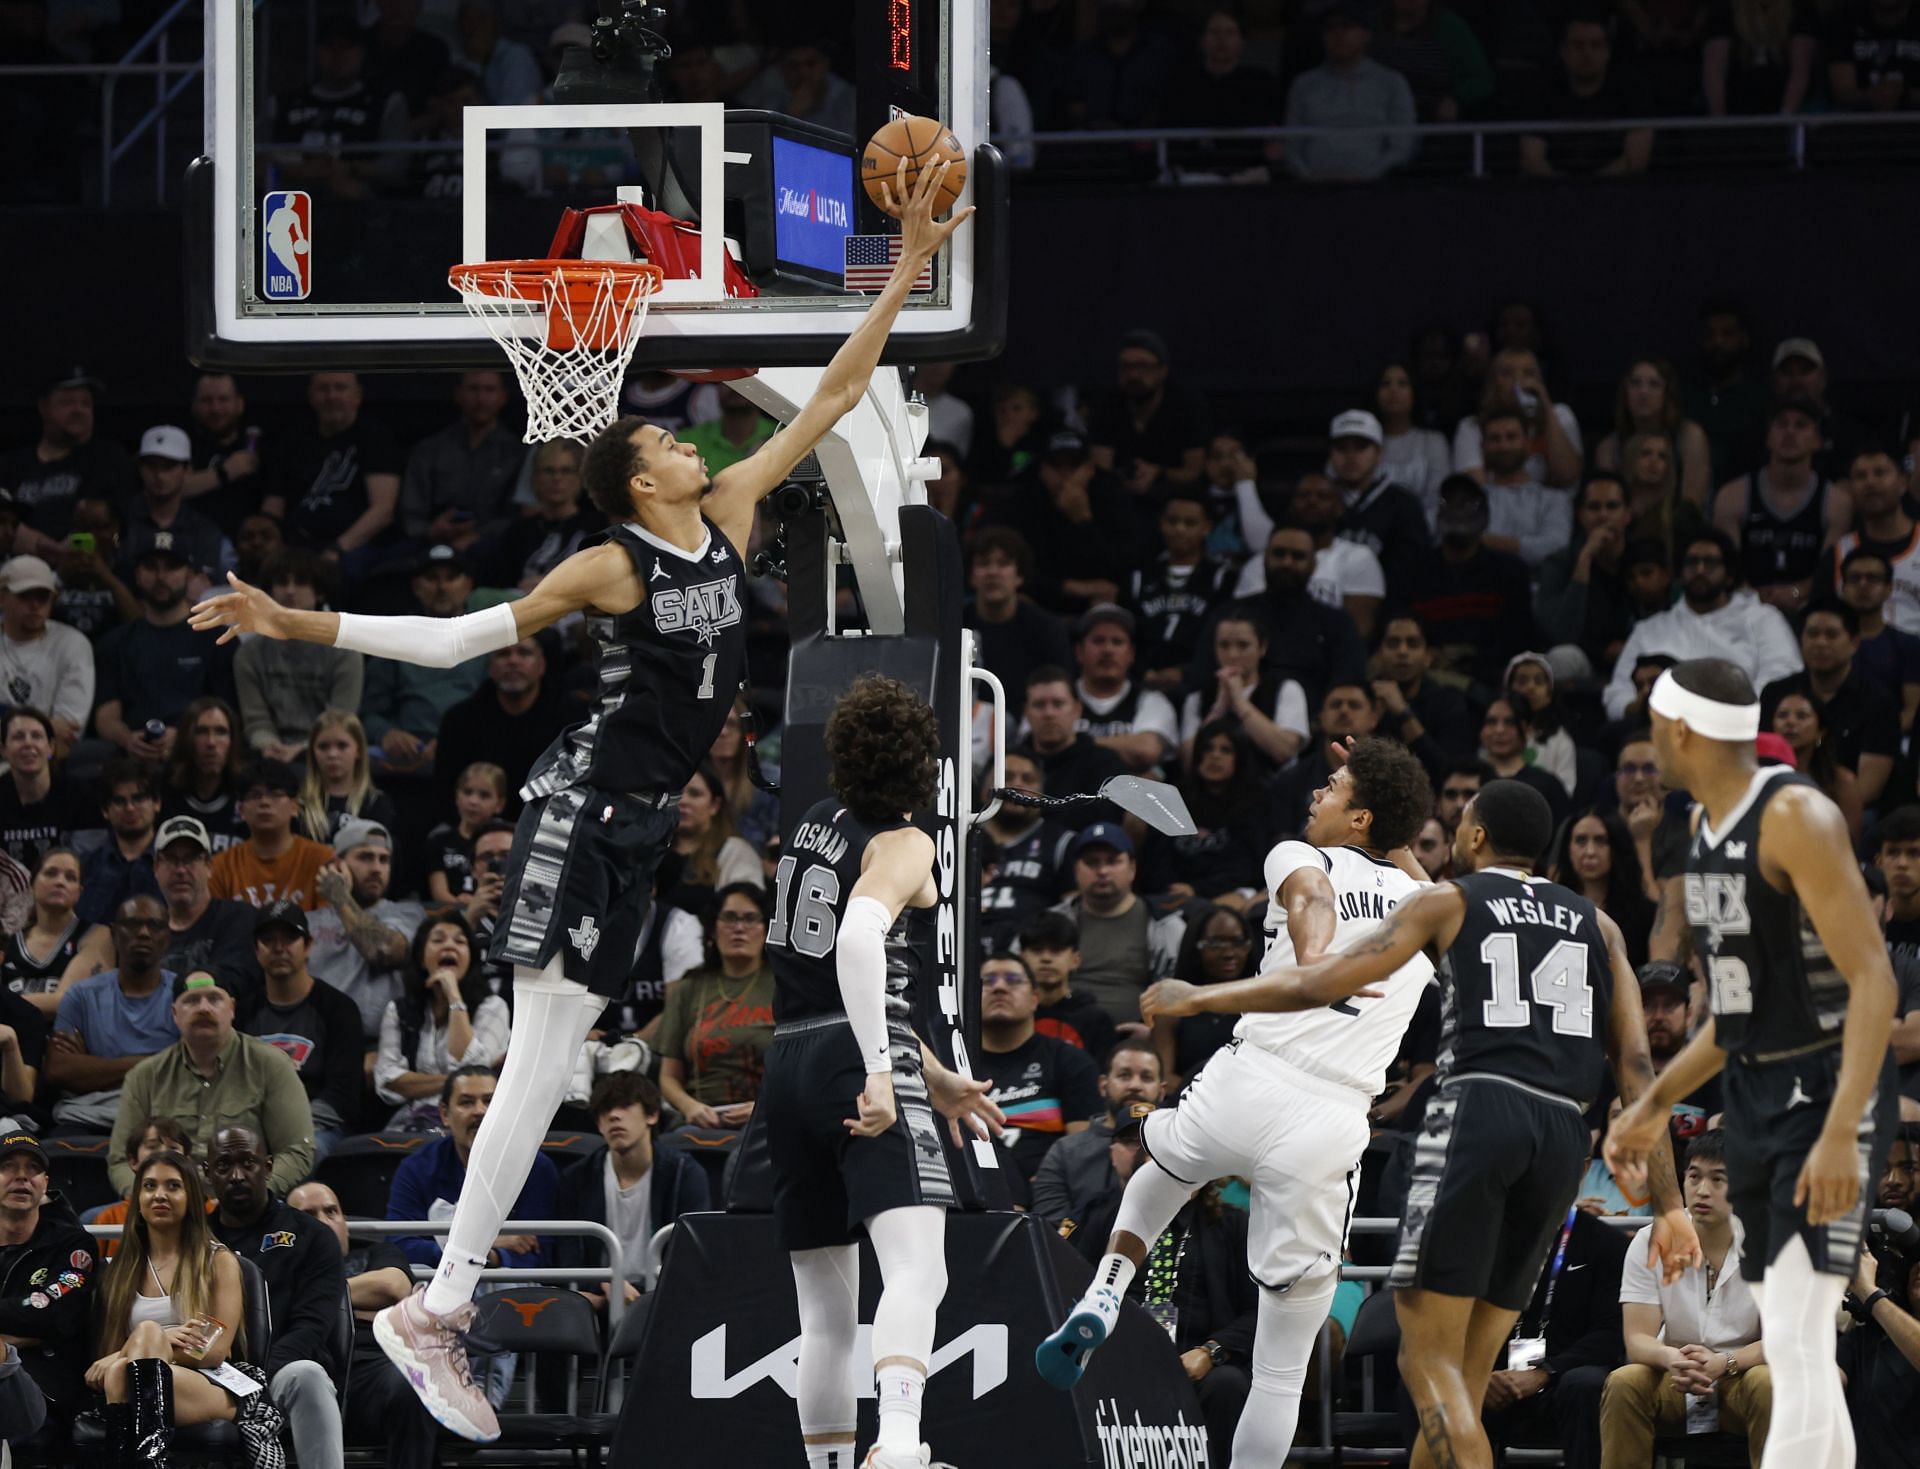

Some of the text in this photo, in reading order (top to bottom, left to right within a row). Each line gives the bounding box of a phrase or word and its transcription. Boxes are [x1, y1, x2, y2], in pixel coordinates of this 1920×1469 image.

[816, 196, 848, 228] ULTRA
[270, 275, 293, 292] NBA
[652, 574, 742, 634] SATX
[697, 653, 717, 699] 1
[3, 826, 58, 841] BROOKLYN
[793, 822, 849, 865] OSMAN
[766, 855, 841, 960] 16
[1485, 897, 1584, 936] WESLEY
[1480, 932, 1594, 1038] 14
[1096, 1397, 1209, 1469] ticketmaster
